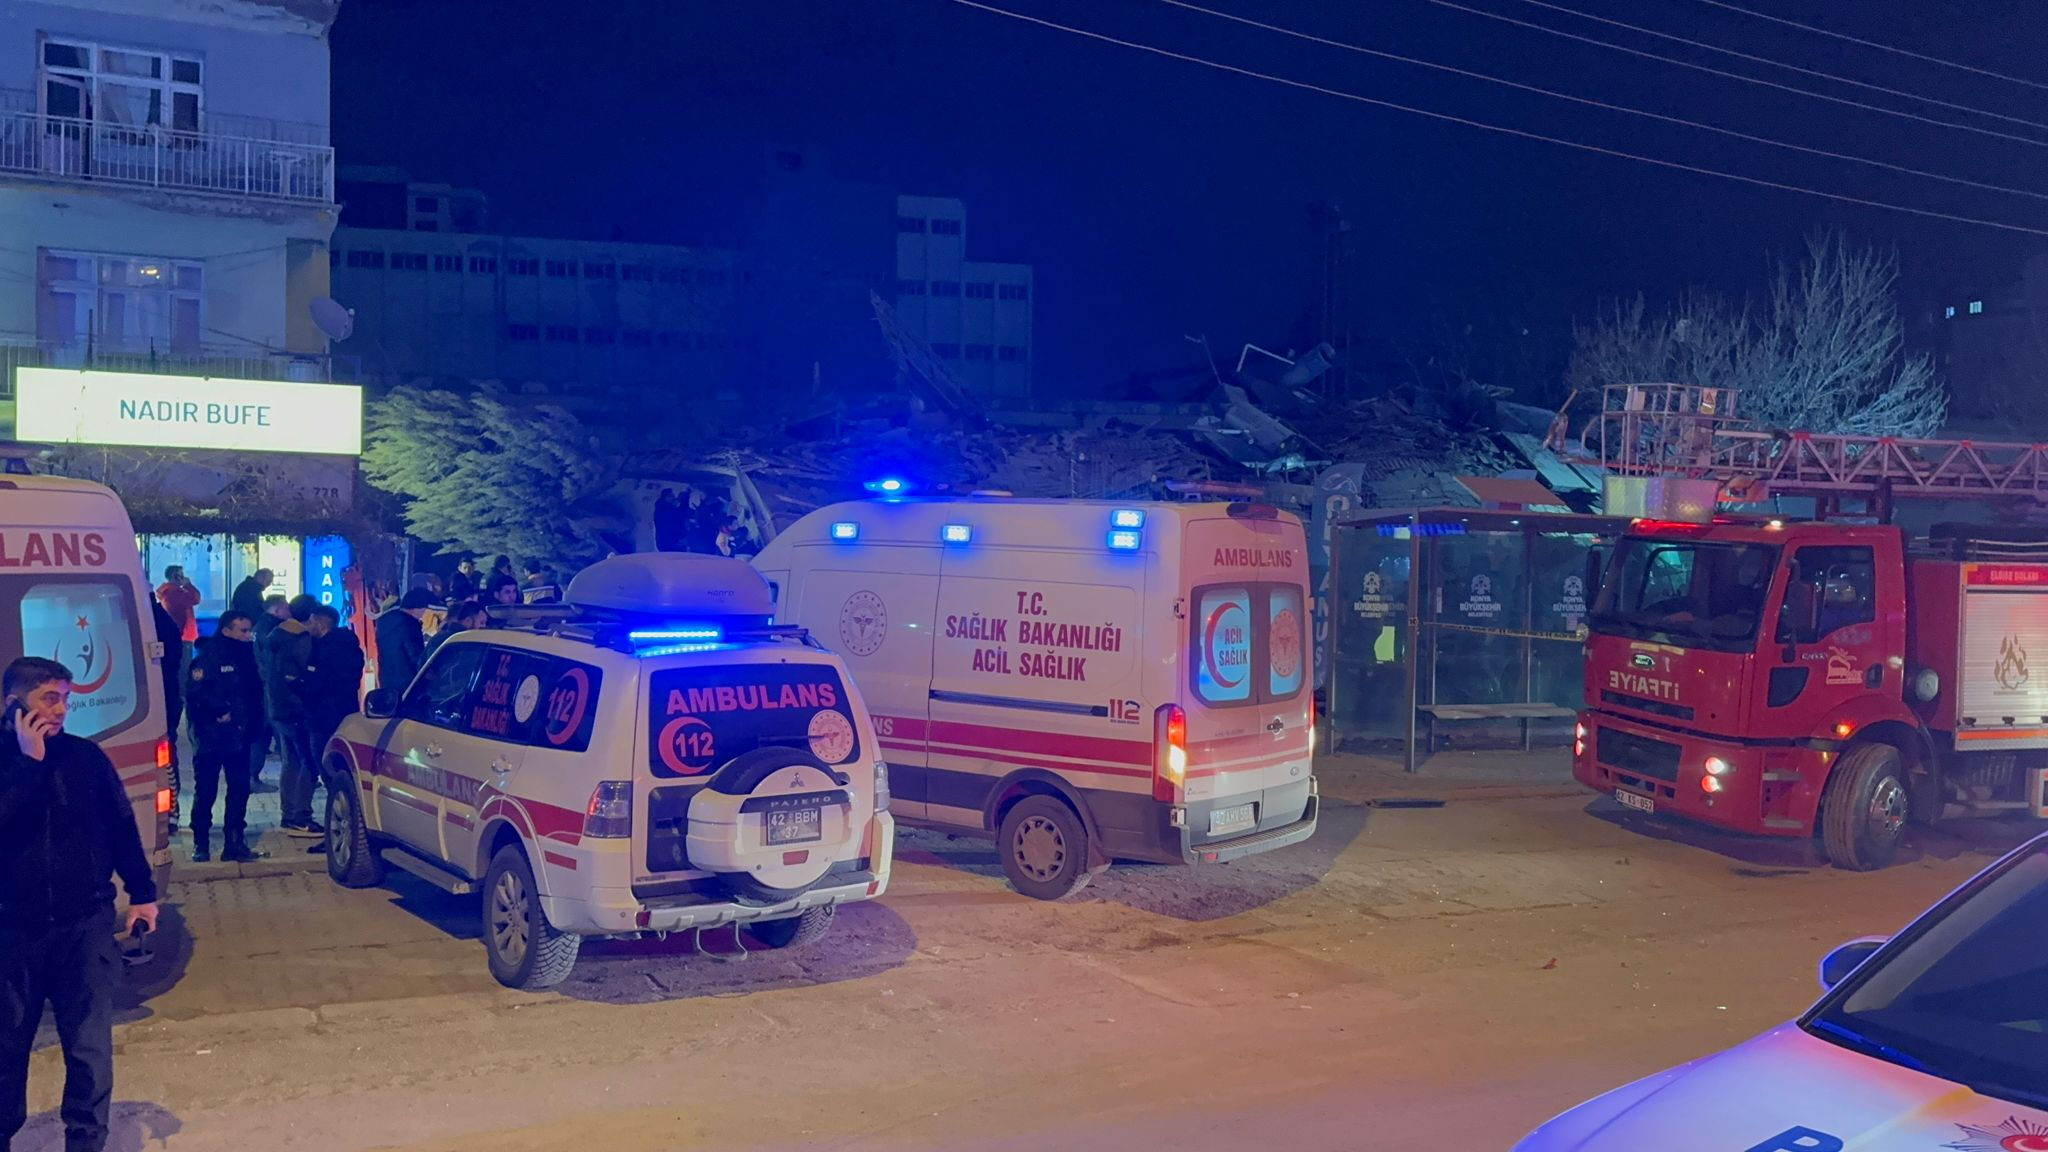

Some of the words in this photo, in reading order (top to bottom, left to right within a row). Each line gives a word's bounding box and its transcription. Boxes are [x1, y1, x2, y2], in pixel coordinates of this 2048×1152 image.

[1214, 547, 1293, 568] AMBULANS
[1017, 591, 1047, 616] T.C.
[945, 612, 1008, 642] SAĞLIK
[1018, 621, 1121, 652] BAKANLIĞI
[972, 646, 1011, 674] ACİL
[1019, 649, 1086, 681] SAĞLIK
[1219, 647, 1248, 666] SAĞLIK
[547, 687, 577, 723] 112
[666, 683, 837, 716] AMBULANS
[1110, 699, 1140, 721] 112
[675, 732, 715, 758] 112
[770, 796, 832, 808] PAJERO
[770, 813, 785, 826] 42
[794, 809, 818, 824] BBM
[784, 825, 799, 838] 37
